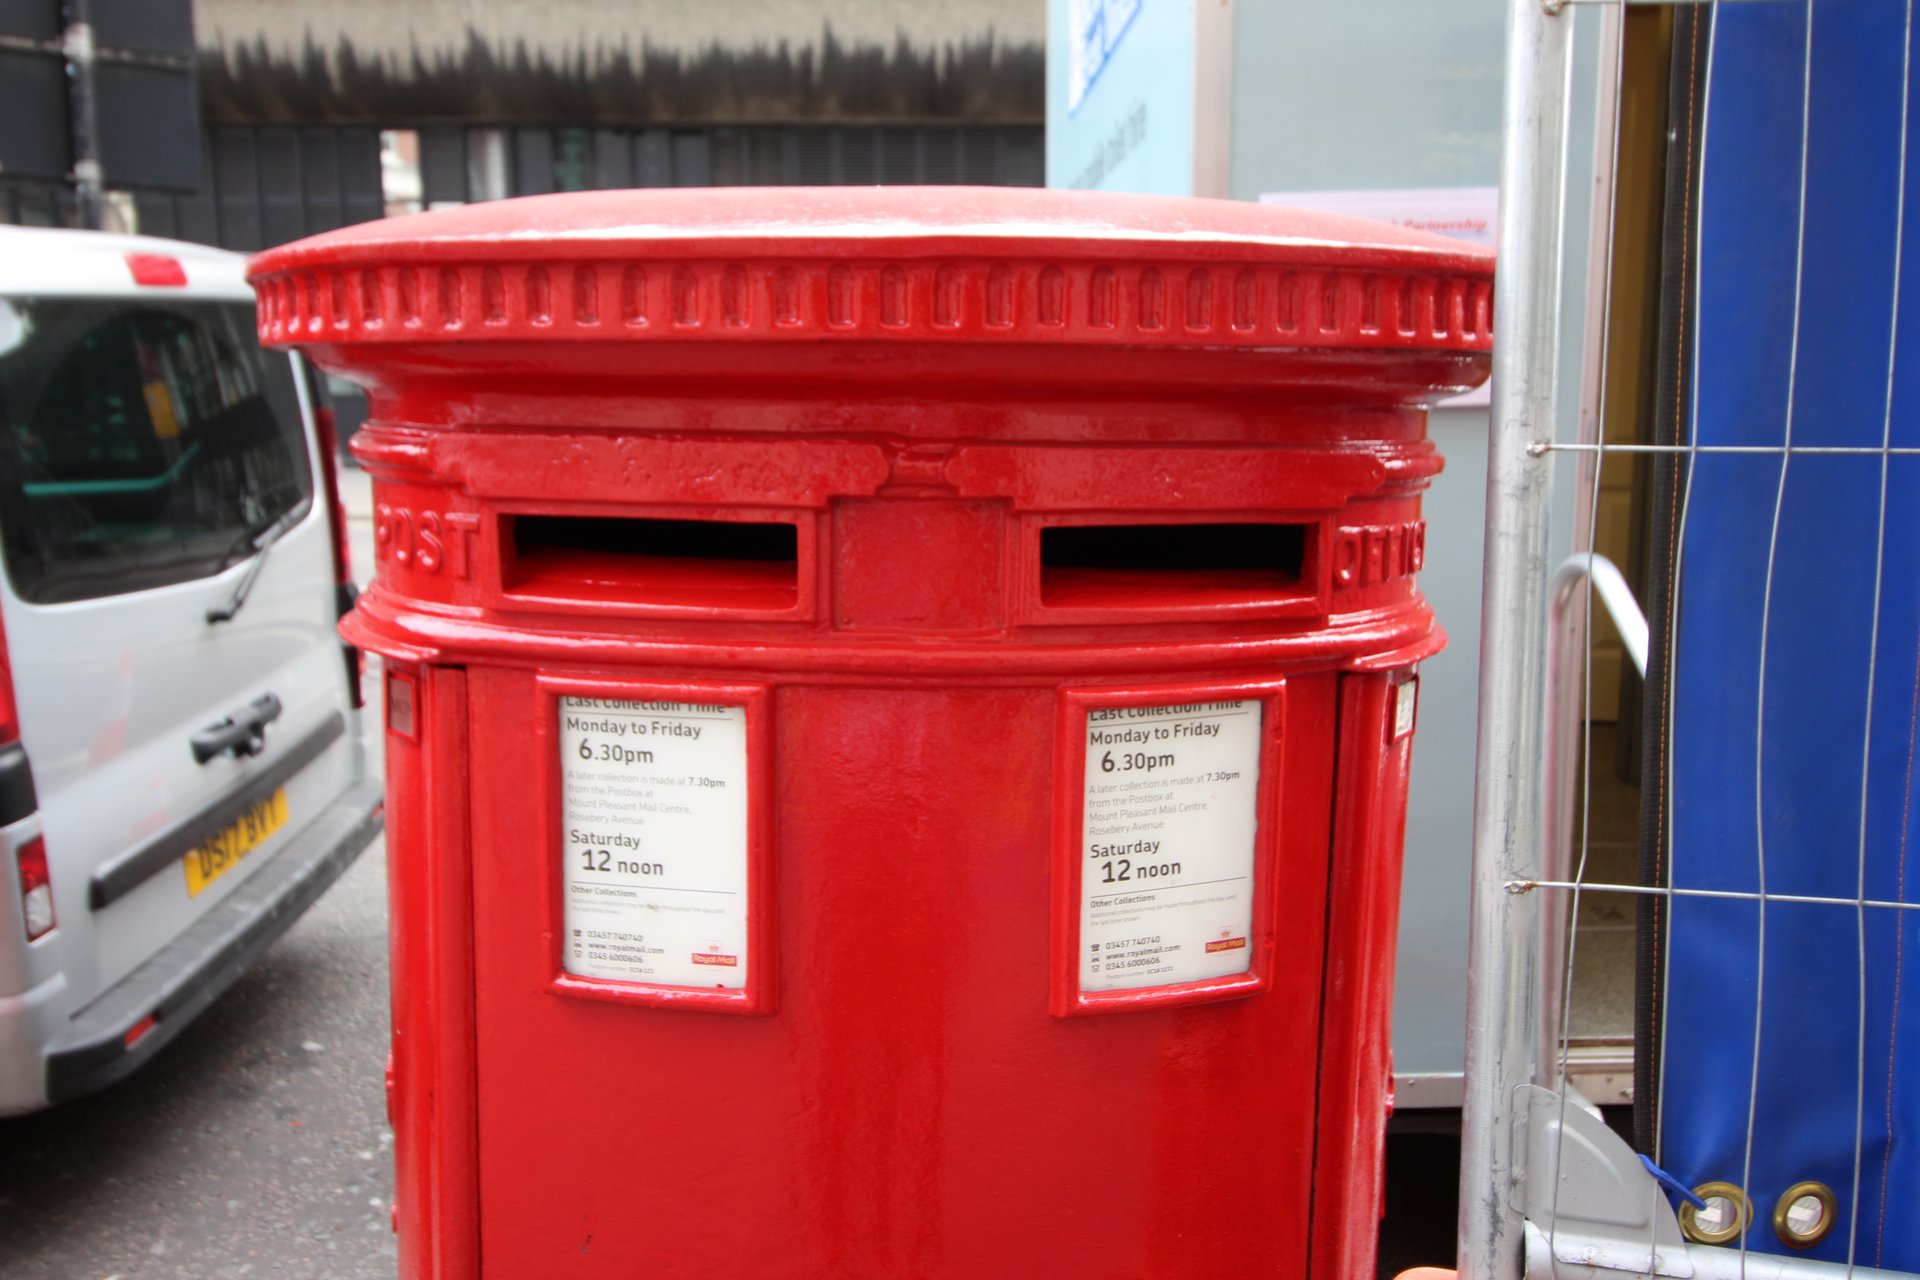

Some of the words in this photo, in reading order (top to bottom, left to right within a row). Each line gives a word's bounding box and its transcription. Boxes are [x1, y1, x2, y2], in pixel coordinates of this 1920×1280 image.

[375, 503, 480, 580] POST
[567, 717, 627, 736] Monday
[631, 721, 647, 735] to
[651, 721, 702, 740] Friday
[1090, 729, 1150, 746] Monday
[1154, 728, 1169, 740] to
[1174, 722, 1221, 739] Friday
[578, 737, 653, 766] 6.30pm
[1101, 750, 1175, 773] 6.30pm
[687, 776, 726, 789] 7.30pm
[1088, 785, 1096, 794] A
[1097, 784, 1118, 794] later
[1119, 780, 1160, 792] collection
[1161, 778, 1169, 787] is
[1170, 776, 1195, 787] made
[1195, 775, 1205, 784] at
[1206, 770, 1240, 782] 7.30pm
[1088, 799, 1111, 809] from
[1112, 796, 1127, 806] the
[1128, 793, 1163, 805] Postbox
[1164, 792, 1174, 801] at
[1089, 812, 1119, 823] Mount
[1119, 808, 1157, 819] Pleasant
[1158, 804, 1177, 815] Mail
[1089, 823, 1131, 837] Rosebery
[1131, 820, 1165, 832] Avenue
[570, 829, 641, 850] Saturday
[1090, 839, 1161, 859] Saturday
[581, 848, 612, 873] 12
[617, 859, 664, 876] noon
[1101, 858, 1131, 884] 12
[1136, 861, 1181, 879] noon
[571, 885, 594, 895] Other
[594, 887, 638, 898] Collections
[1090, 899, 1112, 909] Other
[1113, 894, 1156, 907] Collections
[587, 929, 612, 941] 03457
[613, 932, 643, 943] 740740
[1105, 940, 1131, 951] 03457
[1131, 935, 1161, 947] 740740
[1207, 940, 1228, 952] Royal
[1228, 937, 1245, 948] Mail
[587, 941, 665, 955] www.royalmail.com
[1105, 944, 1181, 961] www.royalmail.com
[588, 951, 607, 962] 0345
[608, 953, 643, 964] 6000606
[694, 954, 716, 966] Royal
[717, 956, 736, 966] Mail
[1105, 961, 1126, 971] 0345
[1126, 956, 1161, 968] 6000606
